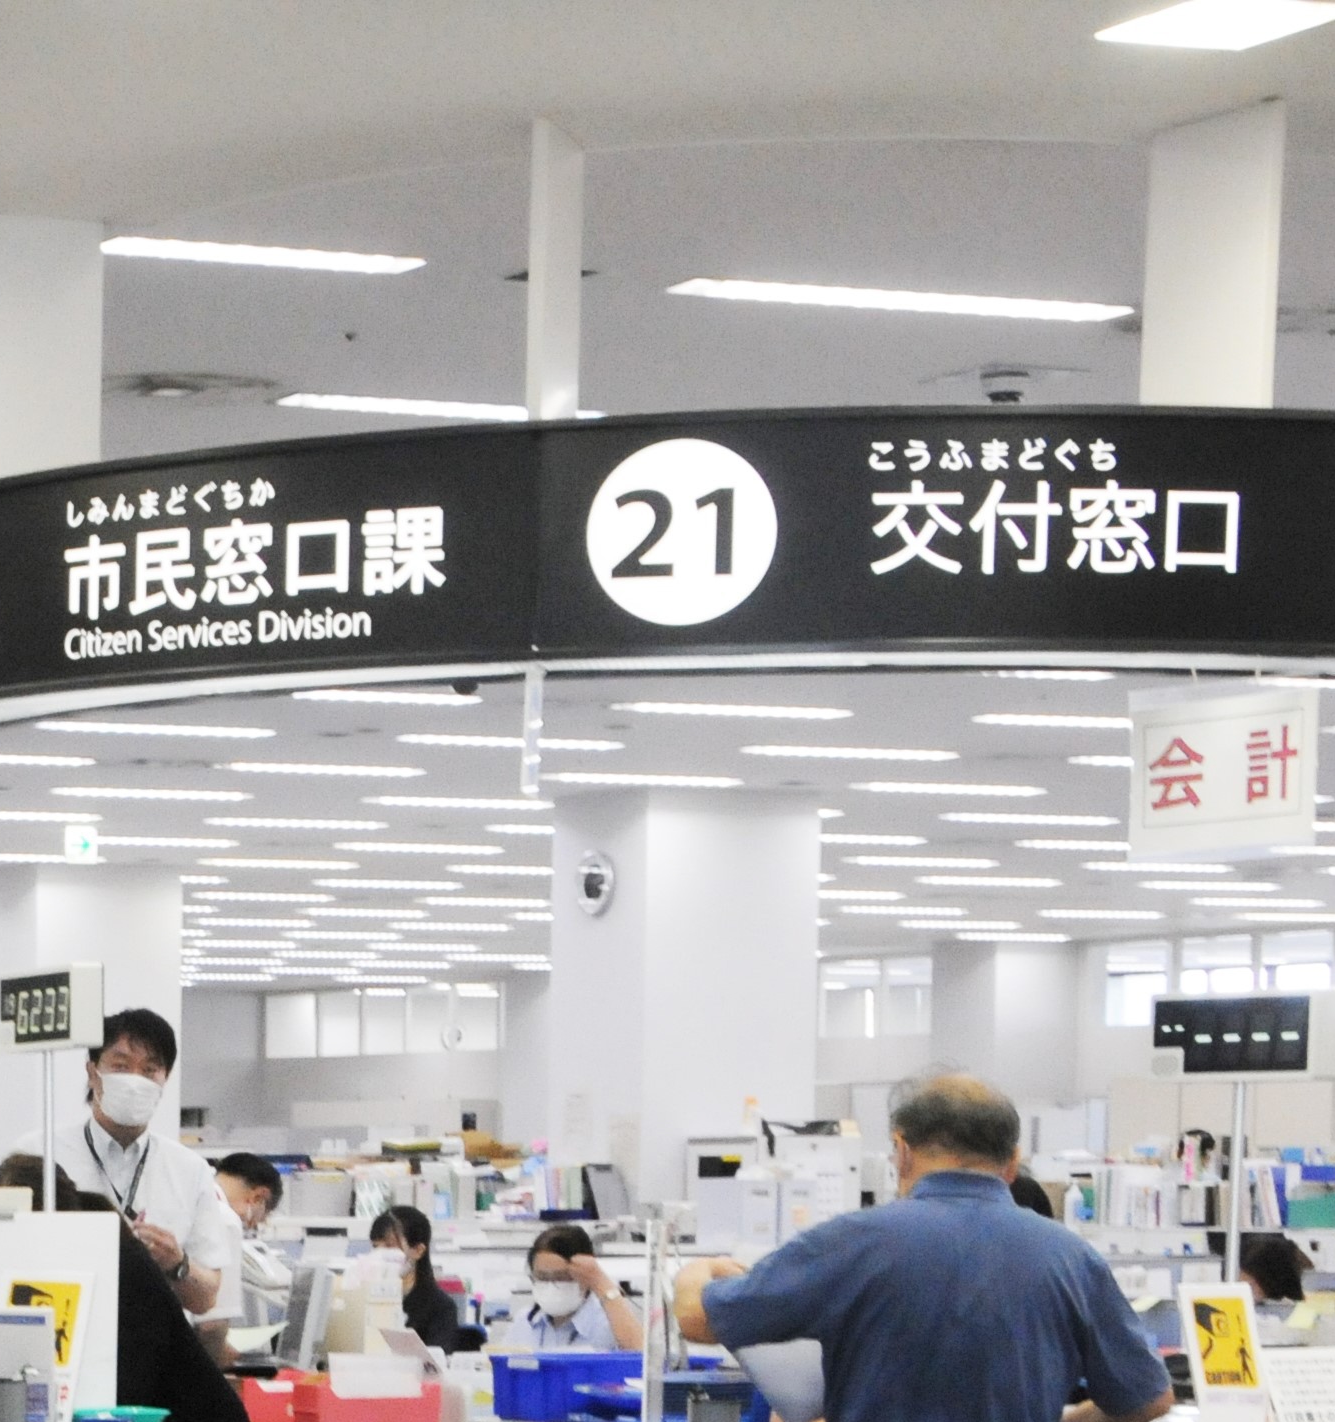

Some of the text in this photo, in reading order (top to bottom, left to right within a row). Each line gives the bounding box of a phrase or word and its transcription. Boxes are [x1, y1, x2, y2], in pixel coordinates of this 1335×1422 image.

[869, 438, 1119, 472] こうふまどぐち
[66, 477, 276, 529] しみんまどぐちか
[611, 486, 736, 578] 21
[870, 479, 1241, 575] 交付窓口
[64, 506, 446, 621] 市民窓口課
[64, 607, 372, 661] Citizen Services Division
[1149, 723, 1299, 812] 会計
[16, 985, 69, 1035] 6233
